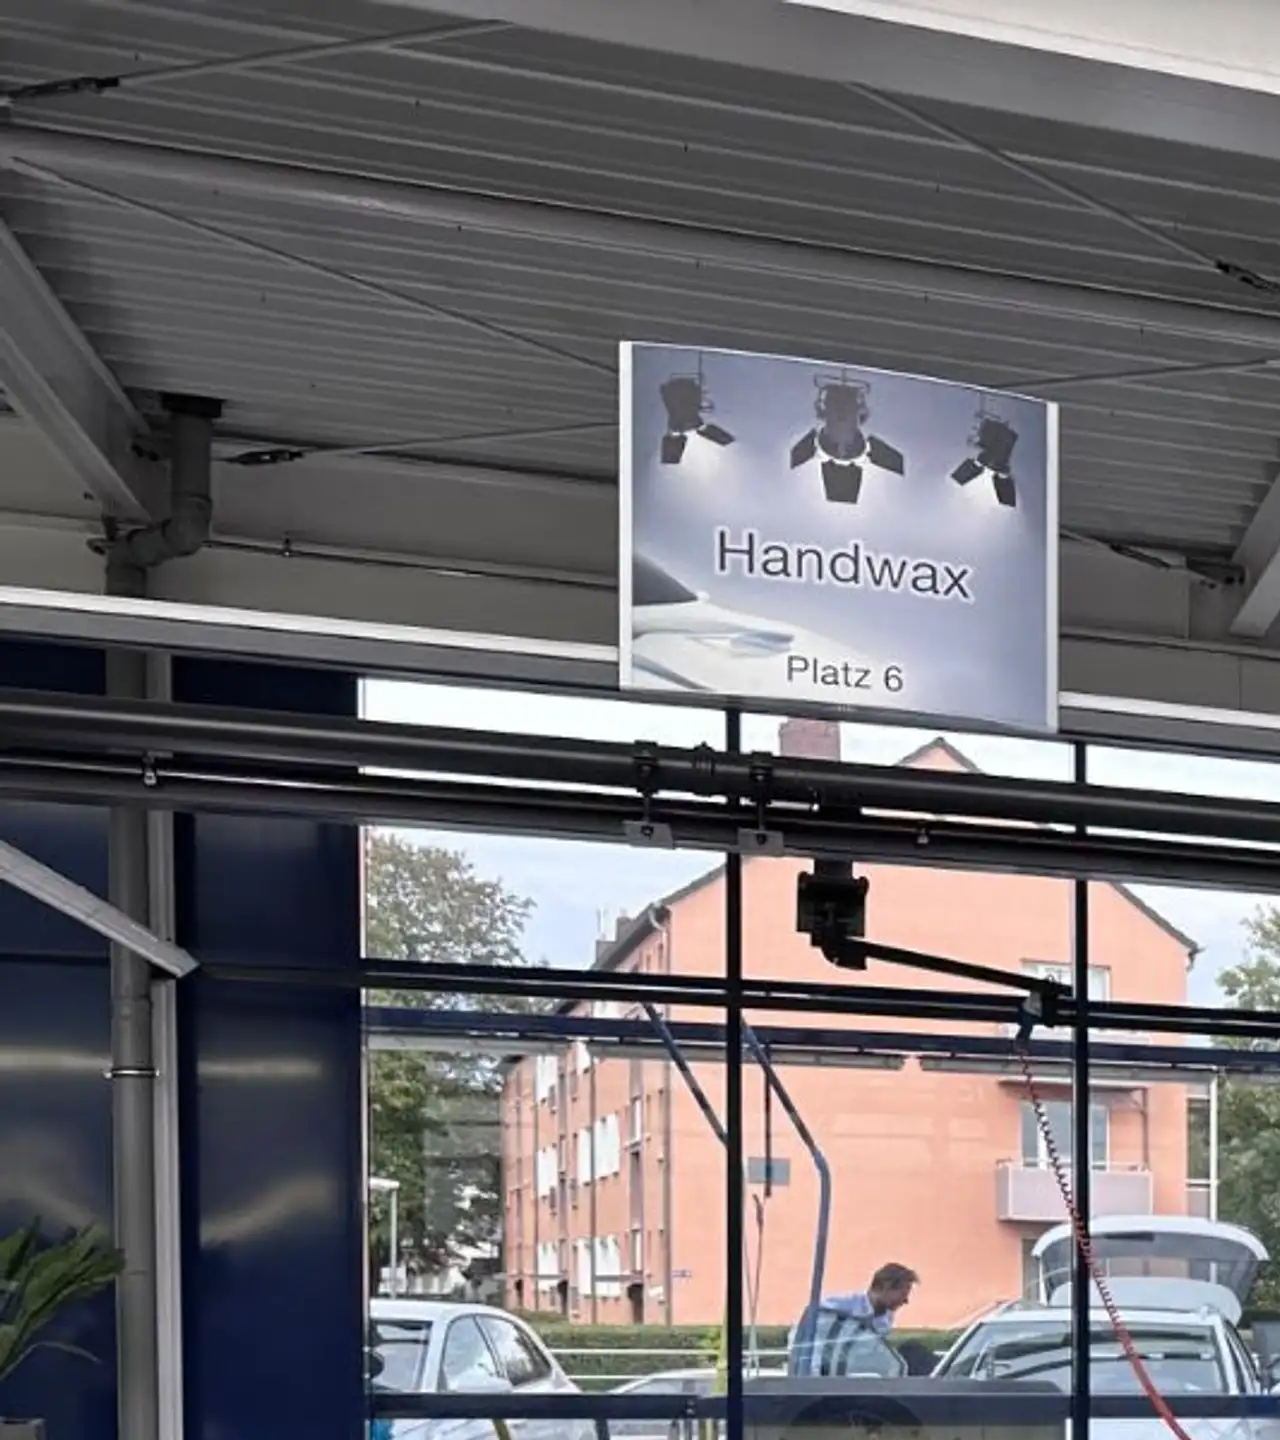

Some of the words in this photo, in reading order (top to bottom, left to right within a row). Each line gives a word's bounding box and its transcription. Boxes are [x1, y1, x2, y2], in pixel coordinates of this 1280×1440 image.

[718, 529, 972, 600] Handwax
[786, 654, 872, 691] Platz
[883, 665, 904, 693] 6
